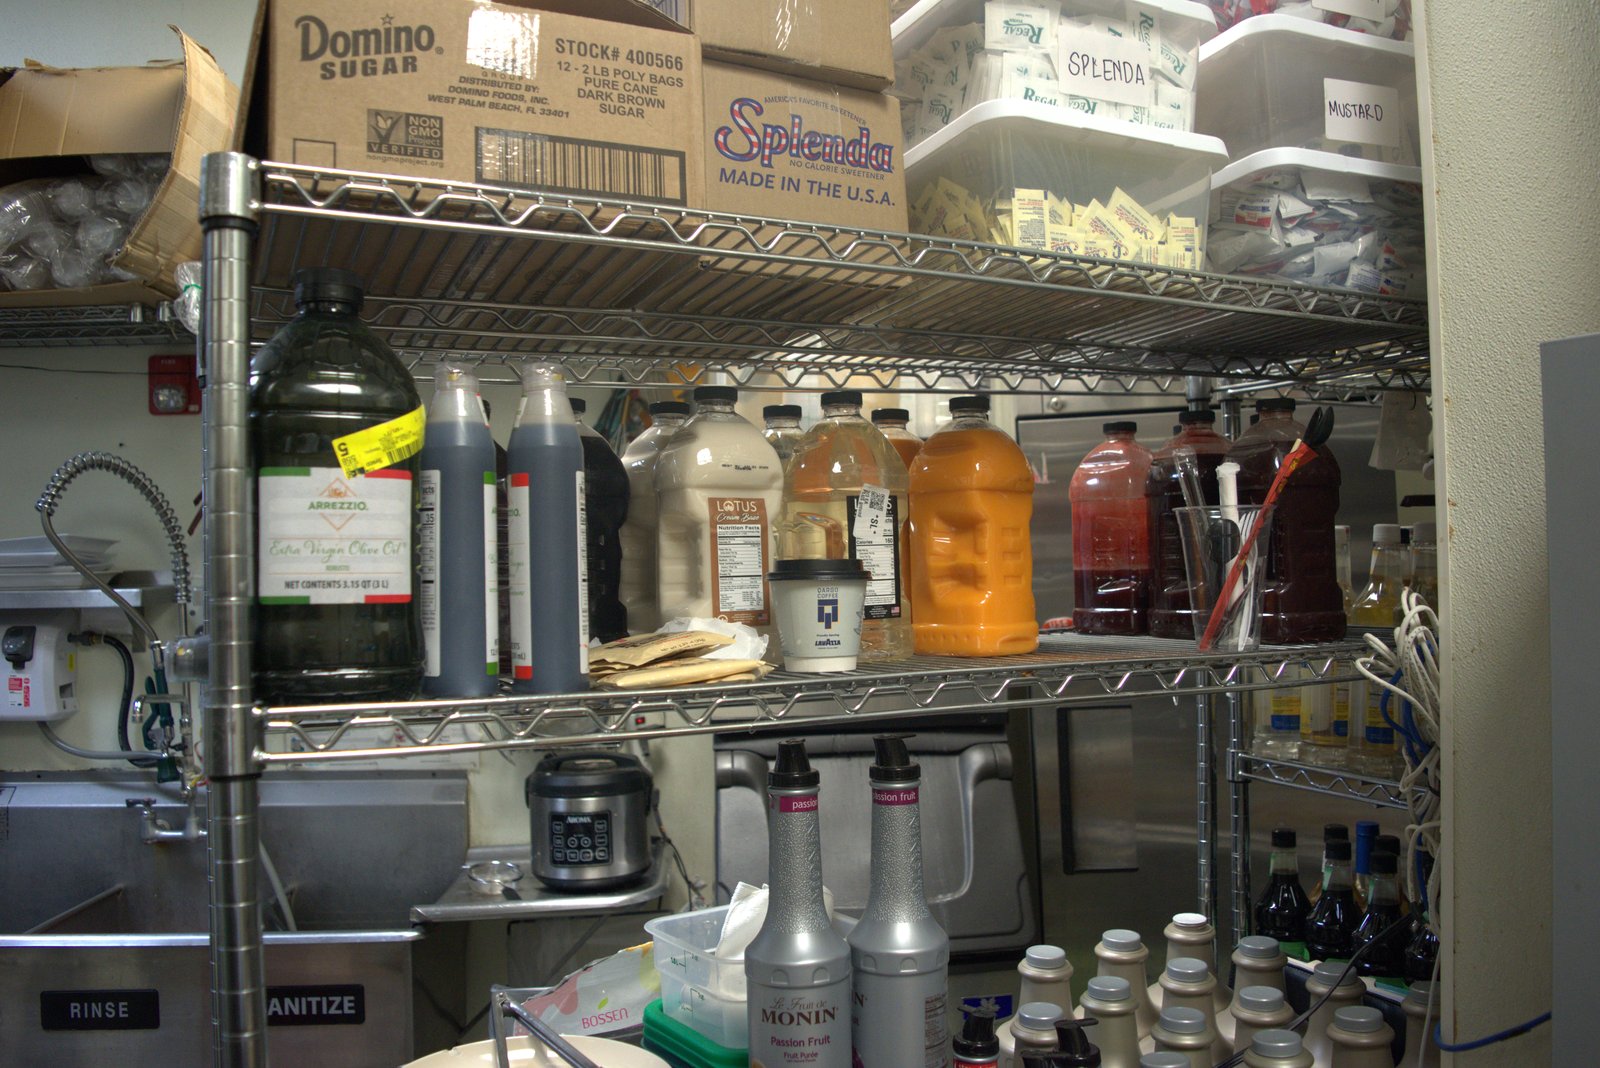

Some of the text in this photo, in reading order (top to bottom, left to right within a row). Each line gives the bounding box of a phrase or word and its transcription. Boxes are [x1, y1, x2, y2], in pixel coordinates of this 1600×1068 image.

[294, 14, 435, 62] Domino
[1003, 20, 1045, 45] REGAL
[555, 37, 684, 72] STOCK# 400566
[319, 55, 418, 80] SUGAR
[557, 60, 571, 73] 12
[582, 63, 590, 76] 2
[593, 65, 609, 78] LB
[613, 67, 647, 83] POLY
[650, 73, 684, 88] BAGS
[1067, 51, 1146, 86] SPLENDA
[448, 84, 550, 106] DOMINO FOODS, INC.
[459, 75, 540, 94] DISTRIBUTED BY:
[584, 76, 658, 97] PURE CANE
[428, 93, 570, 119] WEST PALM BEACH, FL 33401
[577, 87, 665, 109] DARK BROWN
[599, 103, 645, 119] SUGAR
[799, 96, 829, 110] FAVORITE
[830, 104, 867, 127] SWEETENER
[1328, 100, 1384, 122] MUSTARD
[408, 116, 440, 128] NON
[408, 126, 441, 138] GMO
[408, 135, 441, 147] Project
[714, 97, 895, 174] Splenda
[370, 142, 442, 159] VERIFIED
[366, 154, 444, 169] nongmoproject.org
[789, 159, 885, 181] NO CALORIE SWEETENER
[719, 167, 896, 207] MADE IN THE U.S.A.
[308, 501, 366, 511] ARREZZIO
[717, 500, 758, 513] LOTUS
[269, 540, 402, 563] Extra Virgin Olive Oil
[284, 580, 300, 590] NET
[301, 580, 342, 590] CONTENTS
[343, 580, 360, 589] 3.15
[361, 580, 372, 590] QT
[814, 638, 841, 647] LAVAZZA
[900, 791, 916, 801] fruit
[70, 1001, 129, 1019] RINSE
[267, 995, 356, 1016] ANITIZE
[581, 1007, 629, 1030] BOSSEN
[761, 1006, 836, 1027] MONIN
[770, 1034, 831, 1048] Passion Fruit
[783, 1051, 799, 1060] Fruit
